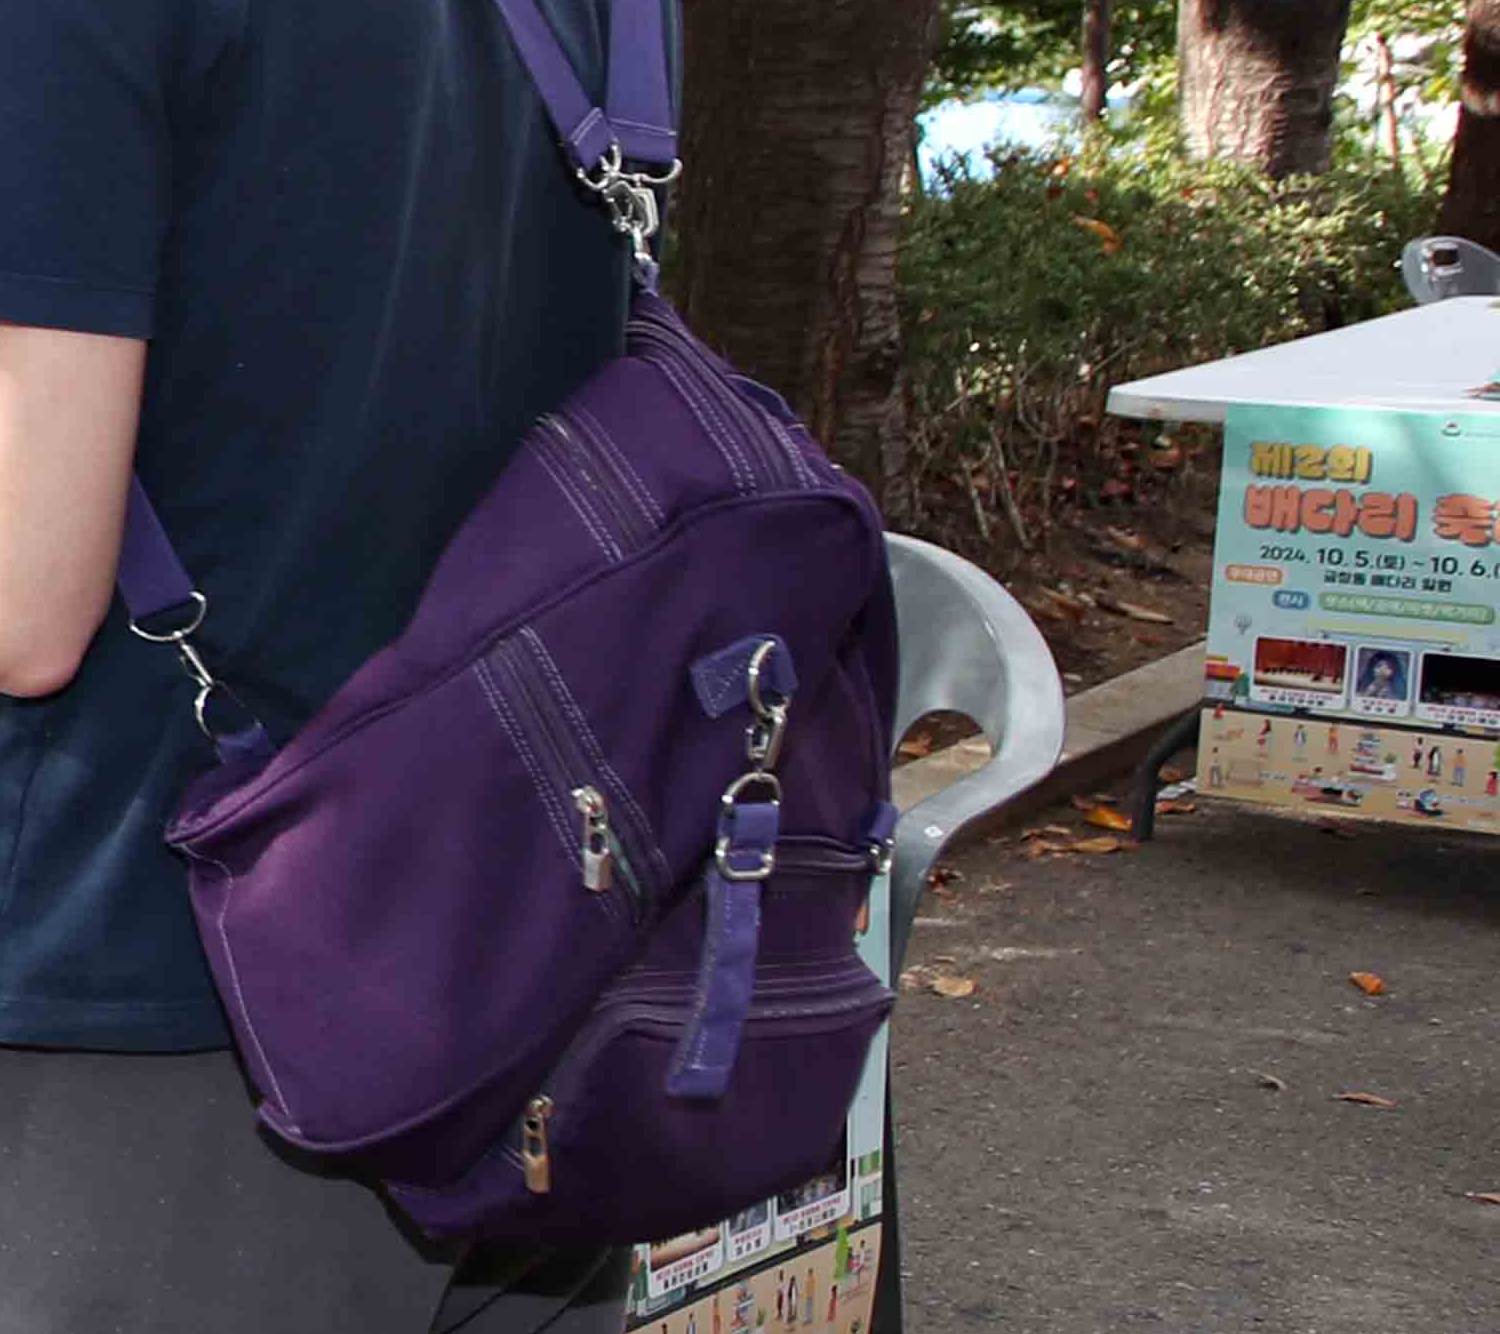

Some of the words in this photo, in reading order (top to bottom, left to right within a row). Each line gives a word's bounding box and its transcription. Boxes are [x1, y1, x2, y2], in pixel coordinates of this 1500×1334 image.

[1252, 443, 1372, 483] 제2회
[1245, 485, 1417, 541] 배다리
[1260, 545, 1309, 564] 2024.
[1316, 547, 1348, 567] 10.
[1430, 556, 1463, 576] 10.
